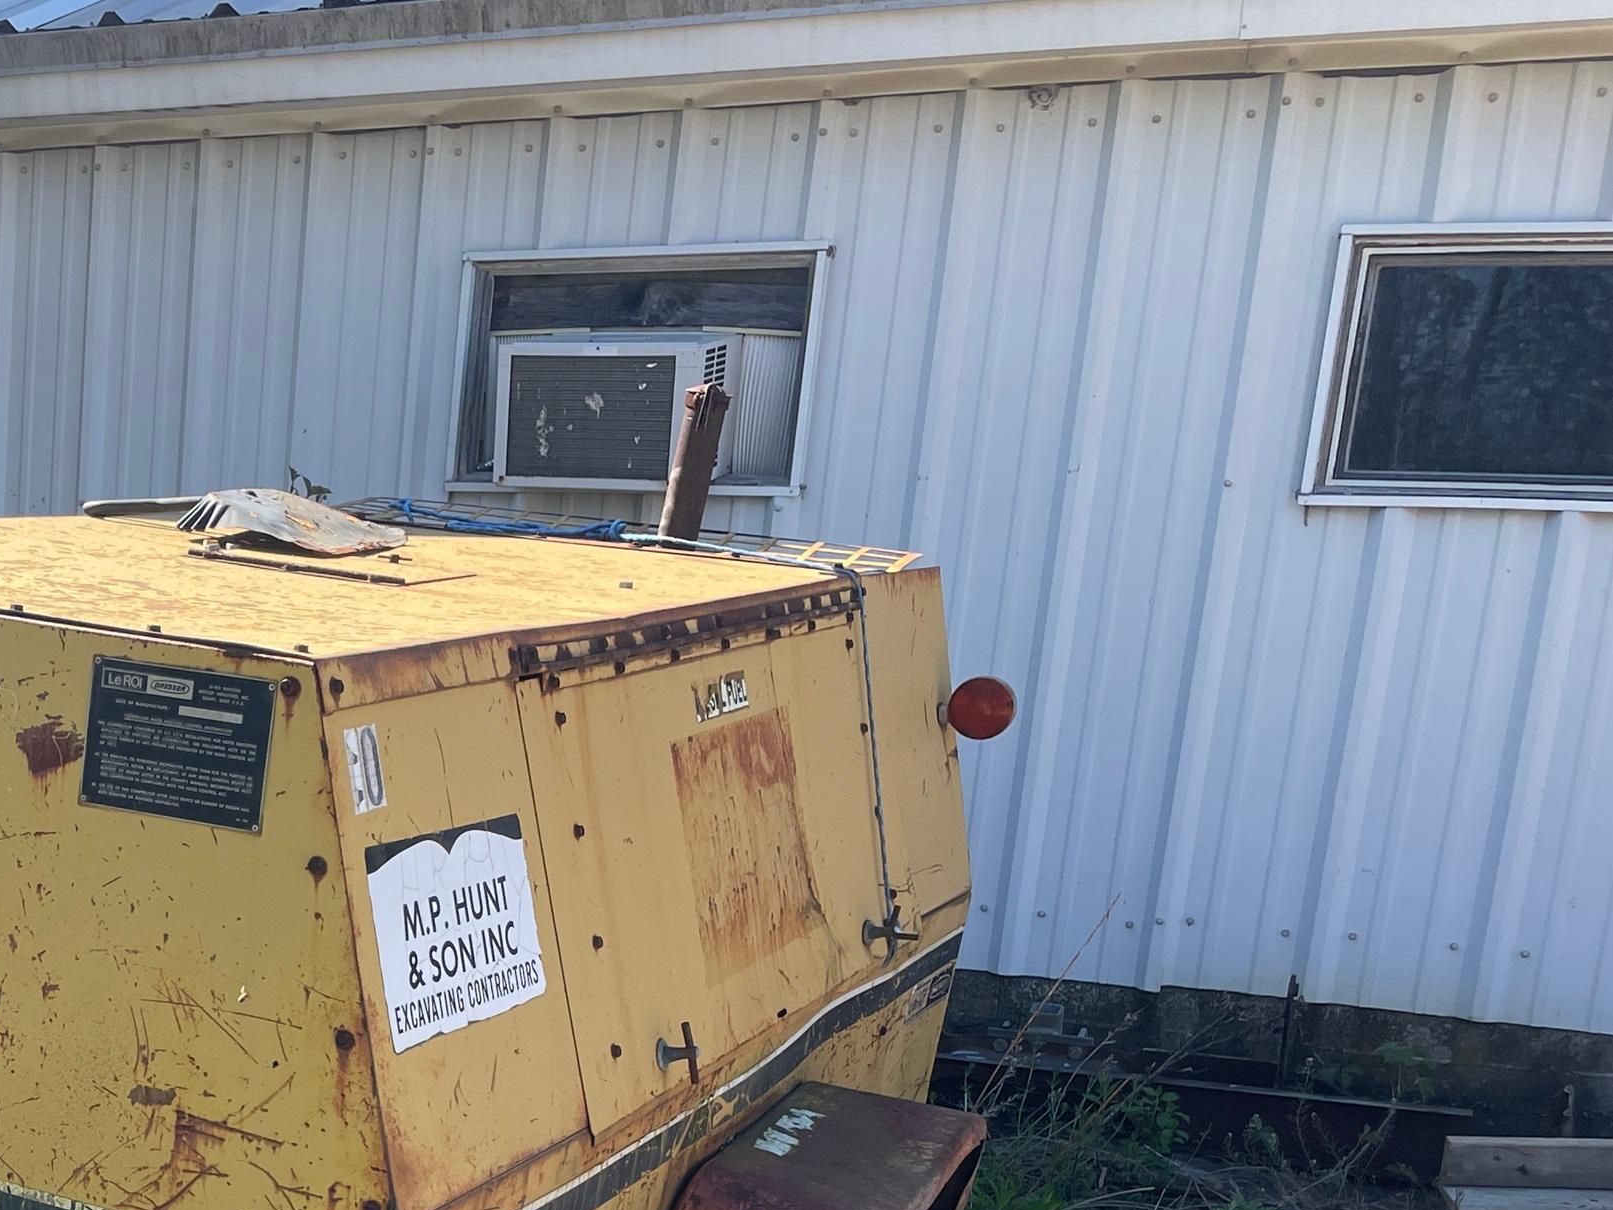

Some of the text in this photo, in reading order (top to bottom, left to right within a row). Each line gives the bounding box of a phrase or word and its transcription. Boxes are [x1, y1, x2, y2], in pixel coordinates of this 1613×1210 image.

[153, 682, 187, 692] DRESSER
[402, 875, 510, 942] M.P. HUNT
[408, 919, 520, 990] & SON INC
[394, 959, 540, 1035] EXCAVATING CONTRACTORS
